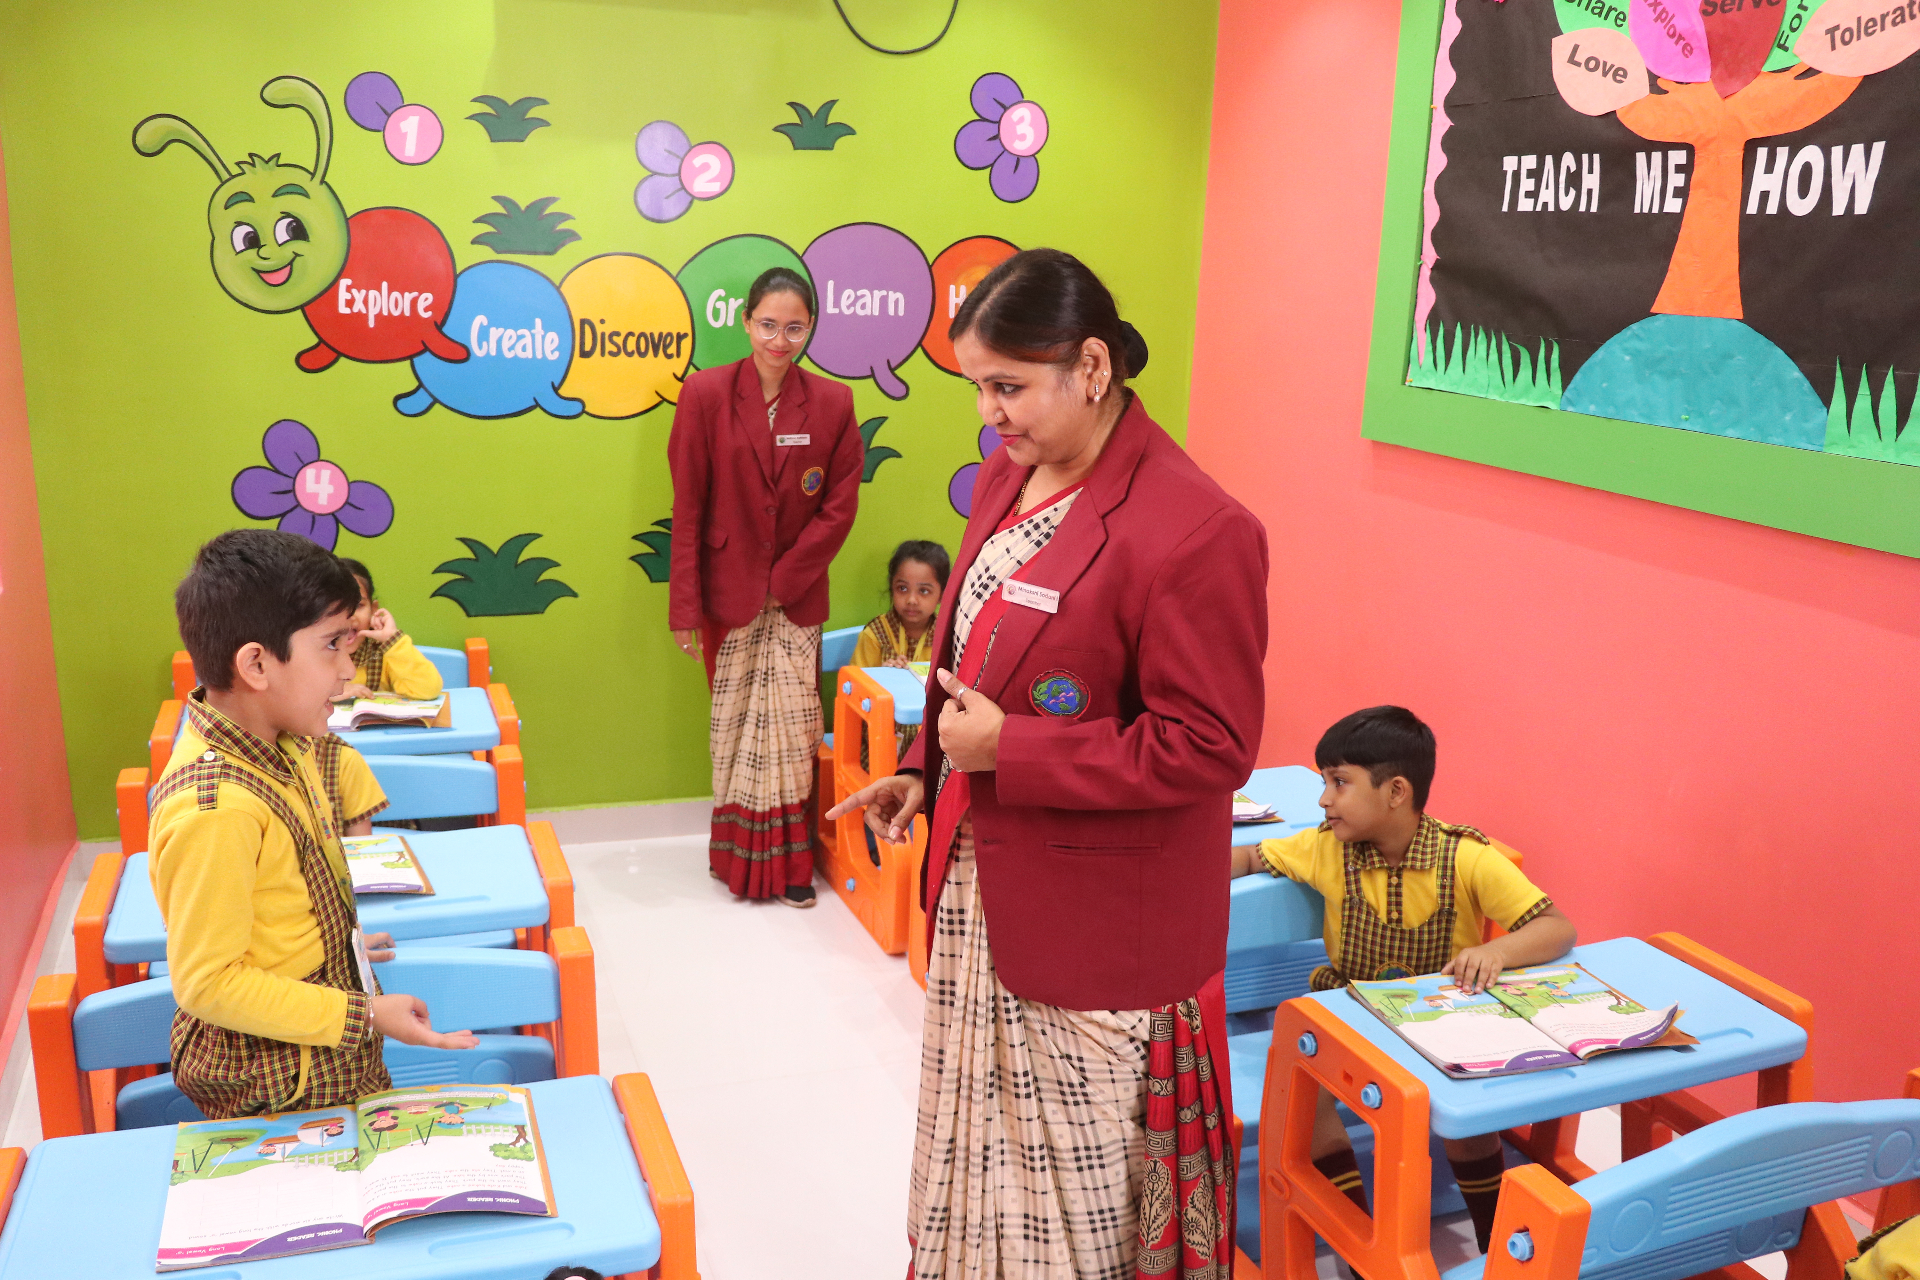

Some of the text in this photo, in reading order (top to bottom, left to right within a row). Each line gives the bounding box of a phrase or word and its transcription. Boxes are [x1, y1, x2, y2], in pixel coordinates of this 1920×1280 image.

[1565, 0, 1626, 28] are
[1643, 0, 1694, 58] xplore
[1776, 0, 1809, 52] For
[1825, 0, 1920, 52] Tolerat
[1566, 44, 1629, 85] Love
[399, 115, 420, 157] 1
[1010, 106, 1036, 150] 3
[692, 153, 722, 193] 2
[1501, 141, 1887, 216] TEACH ME HOW
[338, 278, 434, 328] Explore
[706, 289, 744, 328] Gr
[826, 280, 905, 316] Learn
[949, 285, 967, 318] H
[470, 315, 560, 360] Create
[579, 318, 690, 359] Discover
[304, 468, 334, 504] 4
